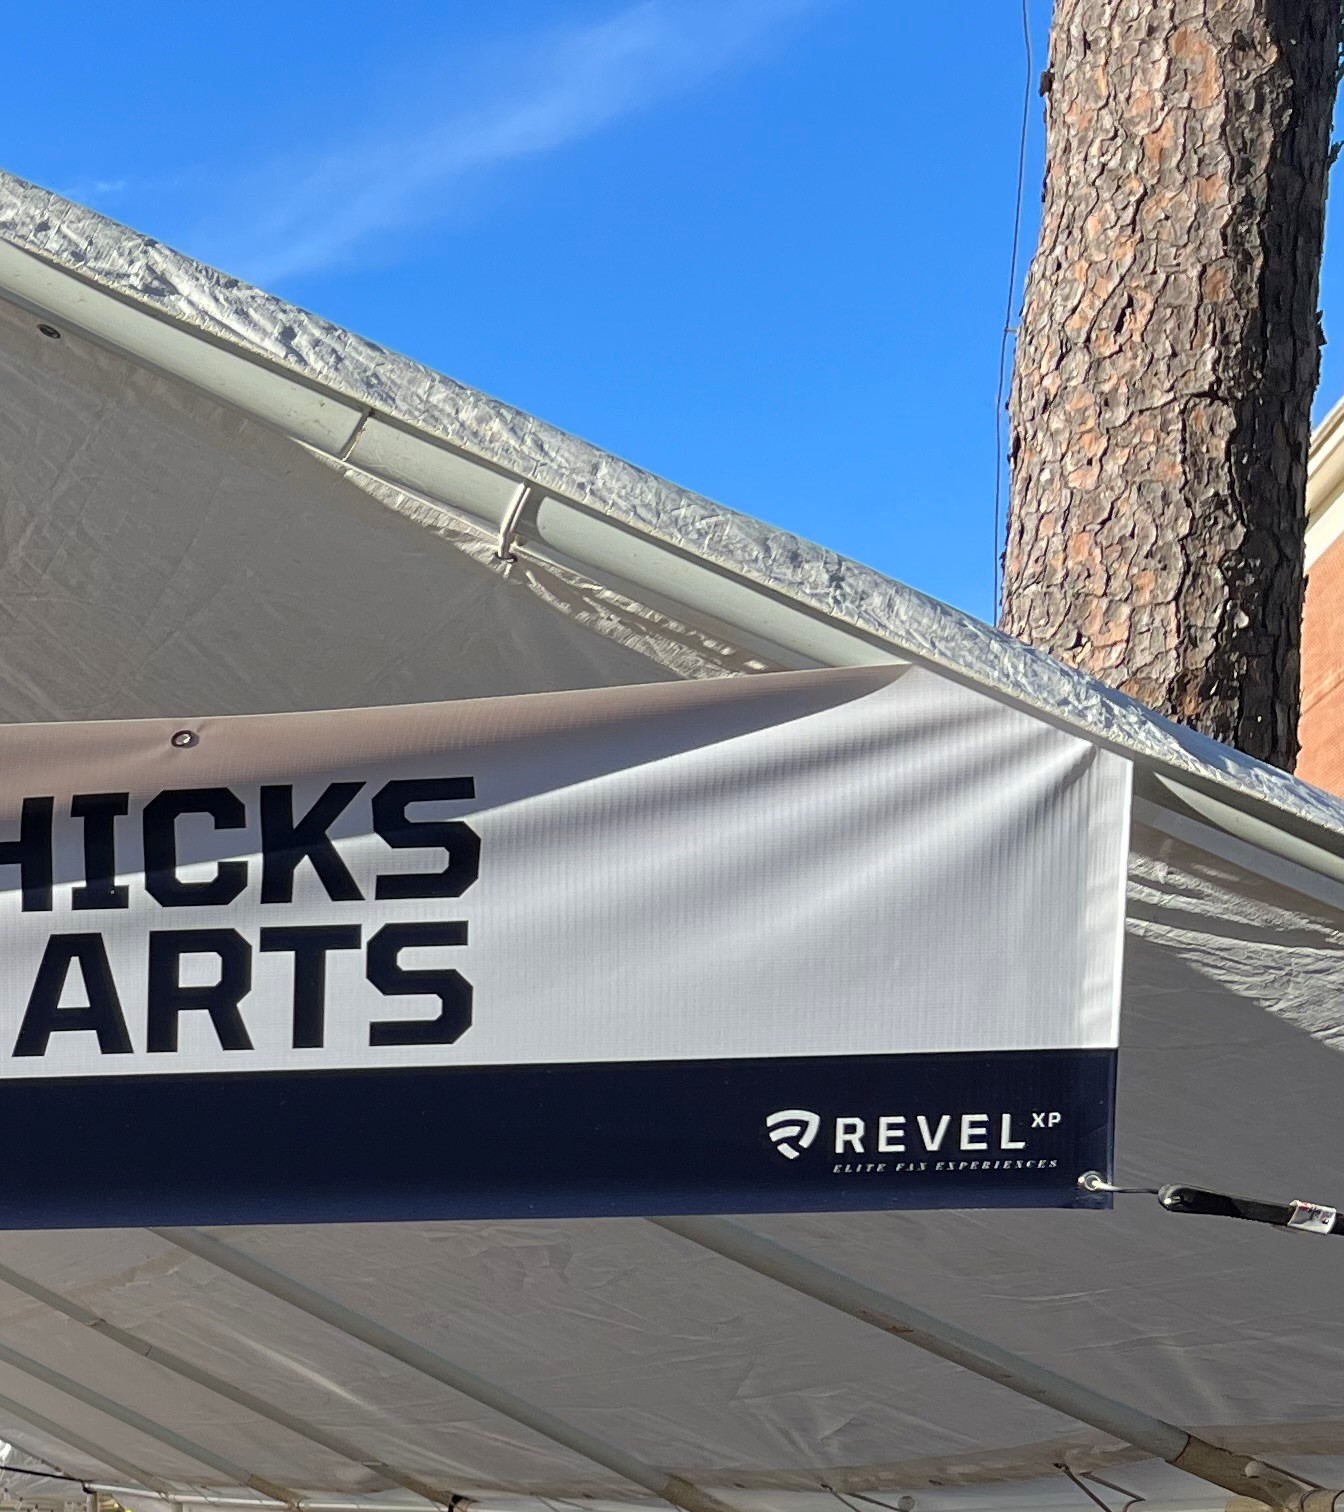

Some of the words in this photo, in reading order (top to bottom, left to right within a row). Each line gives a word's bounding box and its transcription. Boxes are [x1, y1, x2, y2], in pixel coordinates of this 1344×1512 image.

[10, 917, 476, 1059] ARTS
[834, 1112, 1027, 1155] REVEL
[1031, 1110, 1063, 1129] XP
